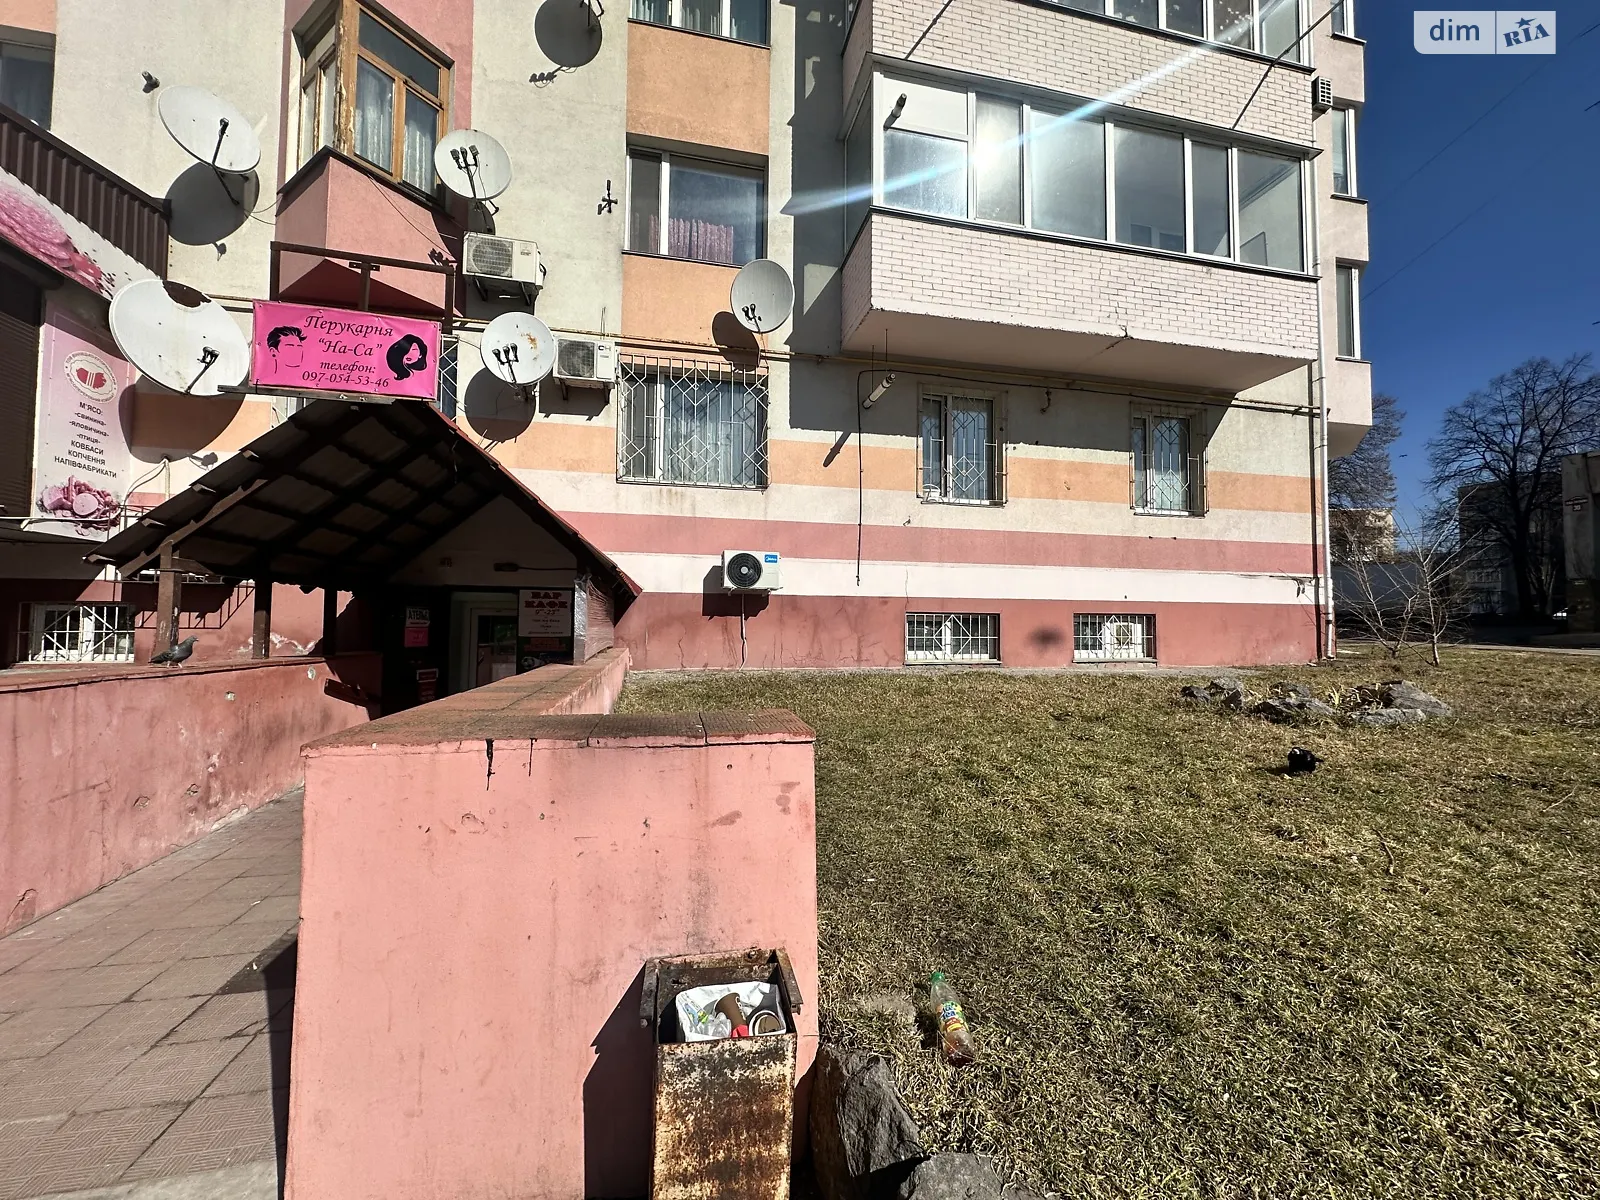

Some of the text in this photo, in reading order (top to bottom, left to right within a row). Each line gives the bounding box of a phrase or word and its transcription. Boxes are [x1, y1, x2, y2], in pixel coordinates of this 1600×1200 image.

[303, 315, 394, 339] Перукарня
[320, 360, 376, 374] телефон:
[302, 370, 389, 388] 097-054-53-46
[70, 439, 104, 456] КОВБАСИ
[67, 449, 106, 466] КОПЧЕННЯ
[54, 456, 117, 478] НАПІВФАБРИКАТИ
